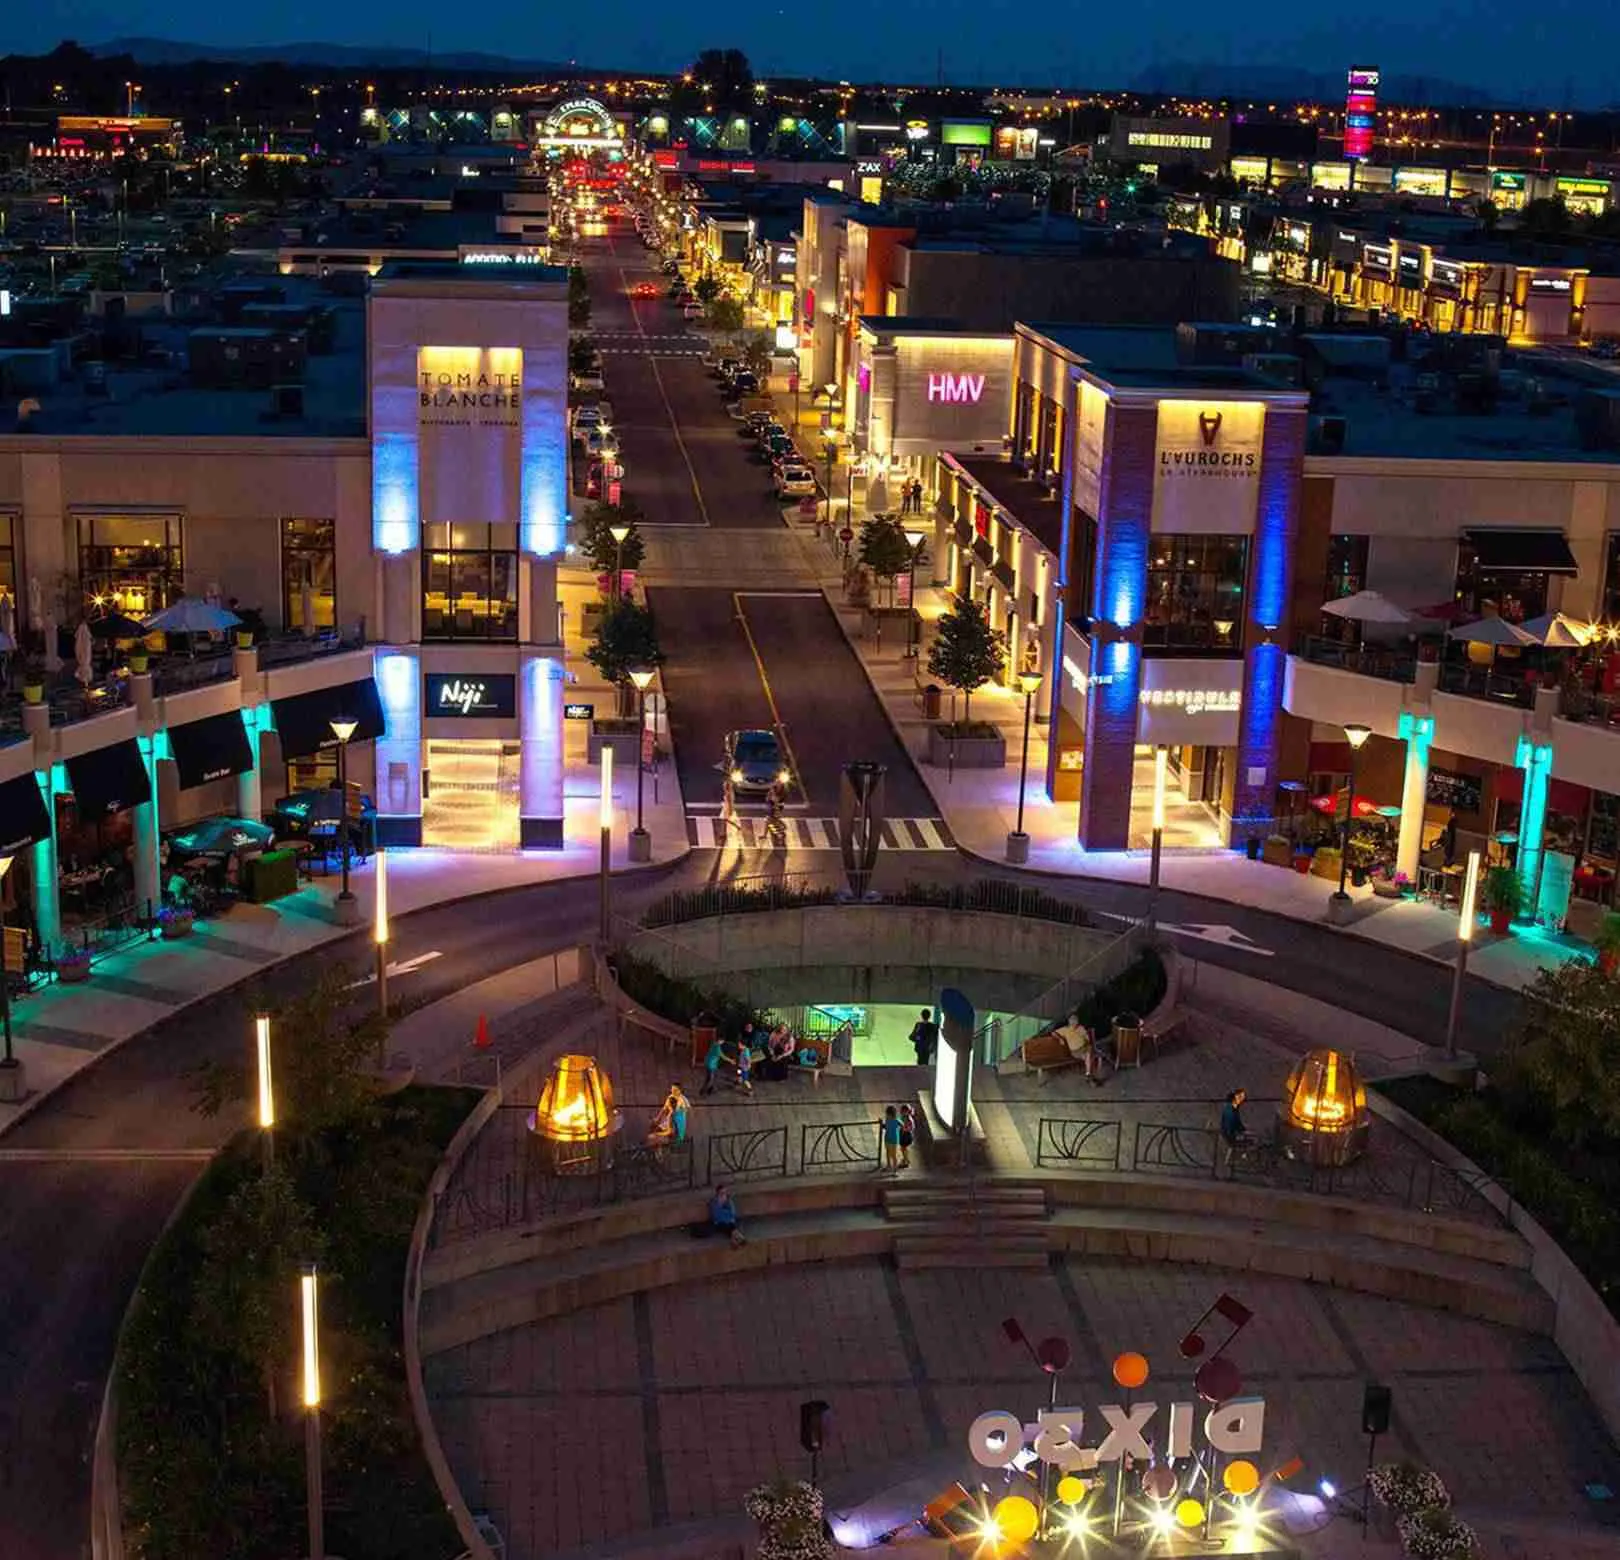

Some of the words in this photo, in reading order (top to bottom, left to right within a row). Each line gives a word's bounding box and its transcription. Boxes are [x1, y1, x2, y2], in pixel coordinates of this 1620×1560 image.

[857, 162, 881, 173] ZAX
[420, 372, 520, 387] TOMATE
[928, 373, 985, 403] HMV
[420, 392, 520, 408] BLANCHE
[440, 679, 486, 714] Niji
